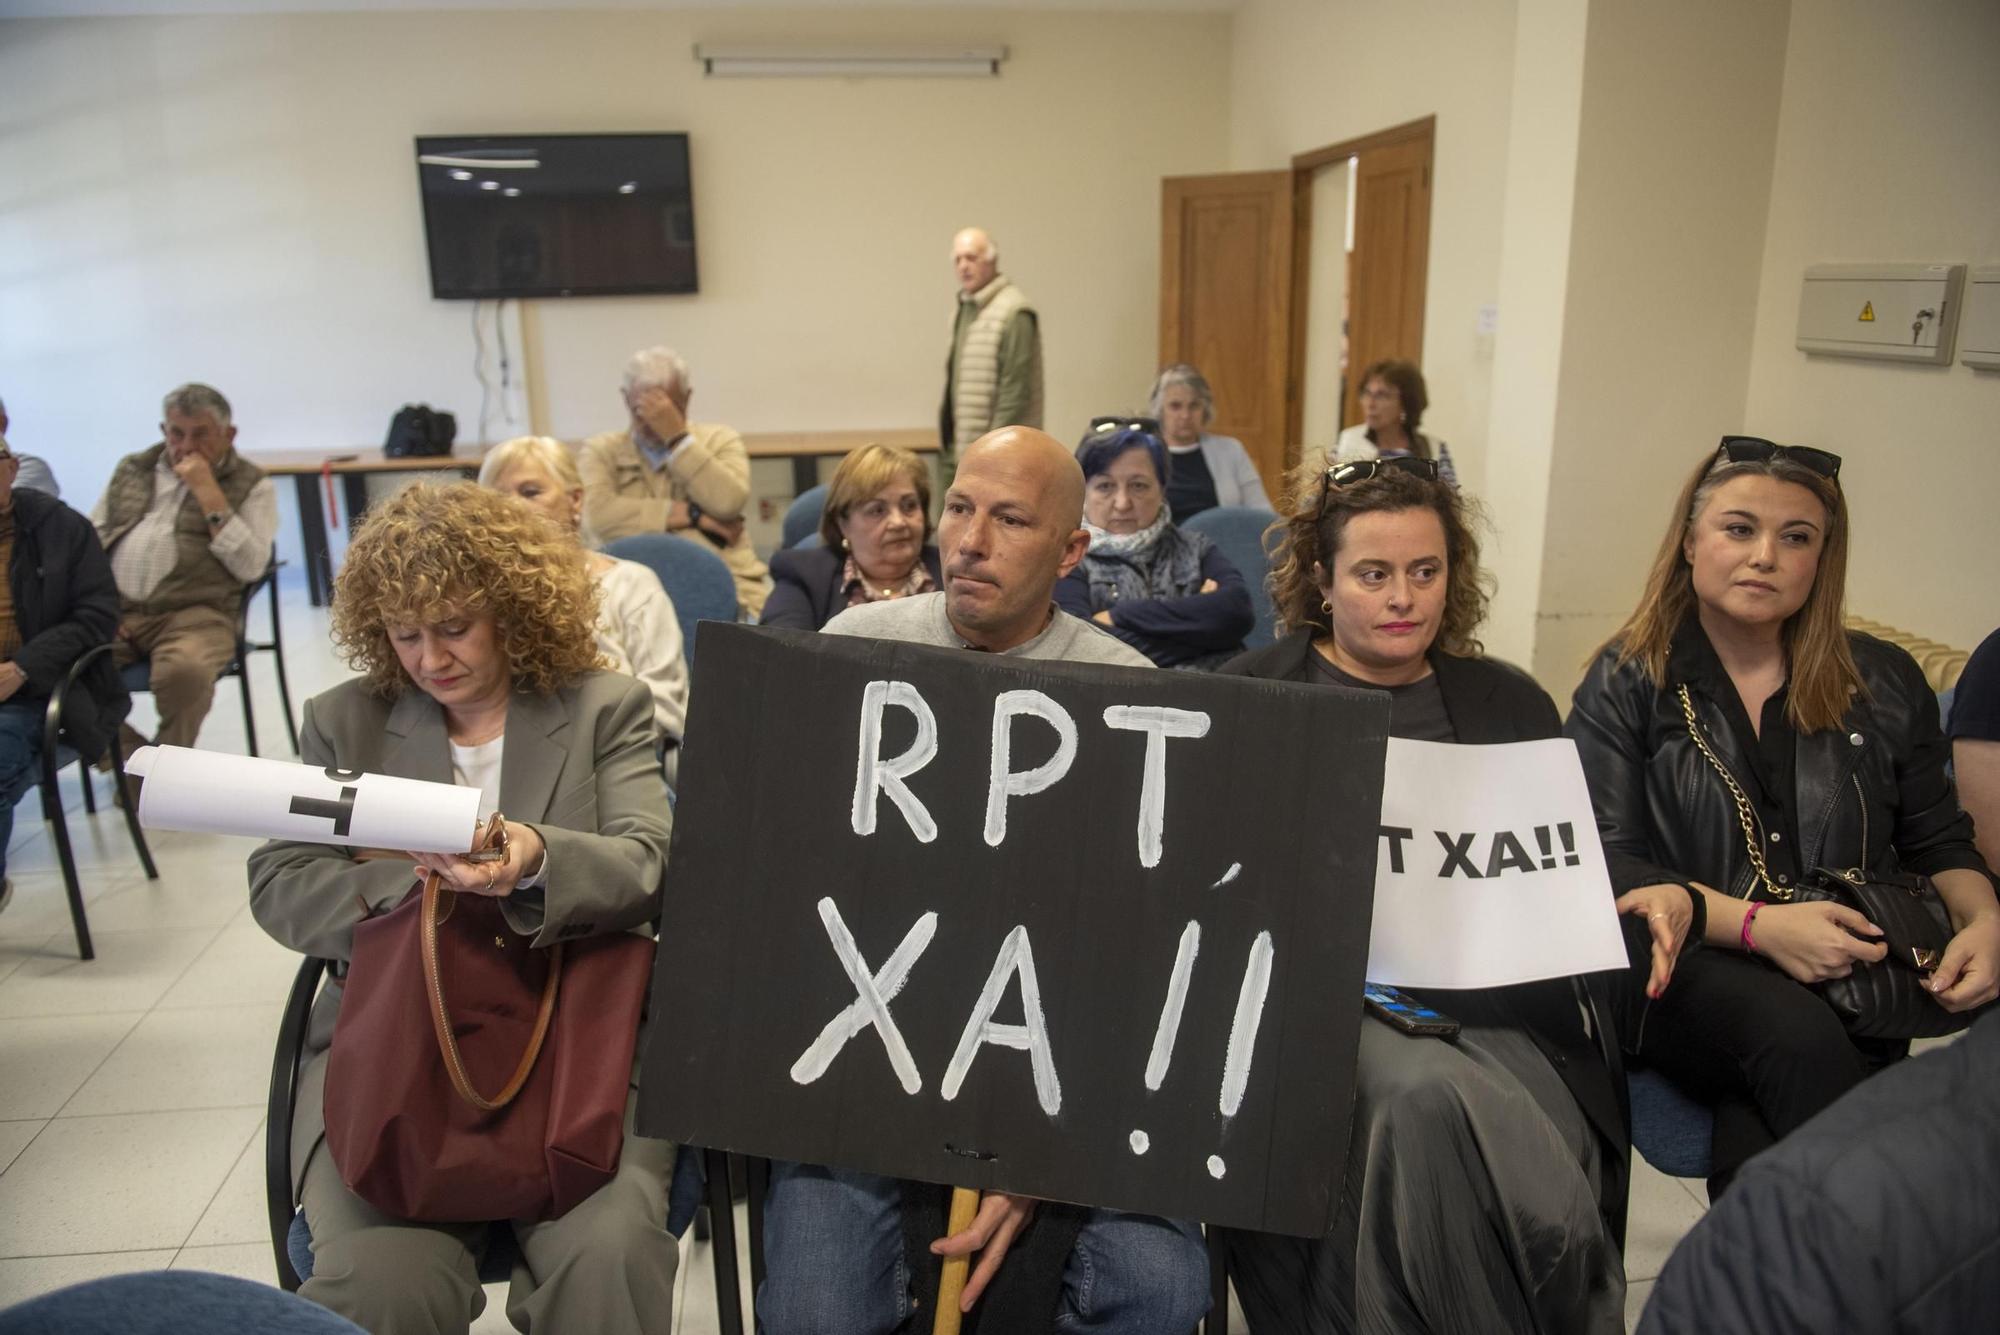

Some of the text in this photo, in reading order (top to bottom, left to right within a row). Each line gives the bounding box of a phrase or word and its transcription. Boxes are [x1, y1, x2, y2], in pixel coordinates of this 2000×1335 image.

[851, 680, 1242, 889] RPT,
[1433, 821, 1581, 879] XA!!
[789, 896, 1275, 1180] XA!!
